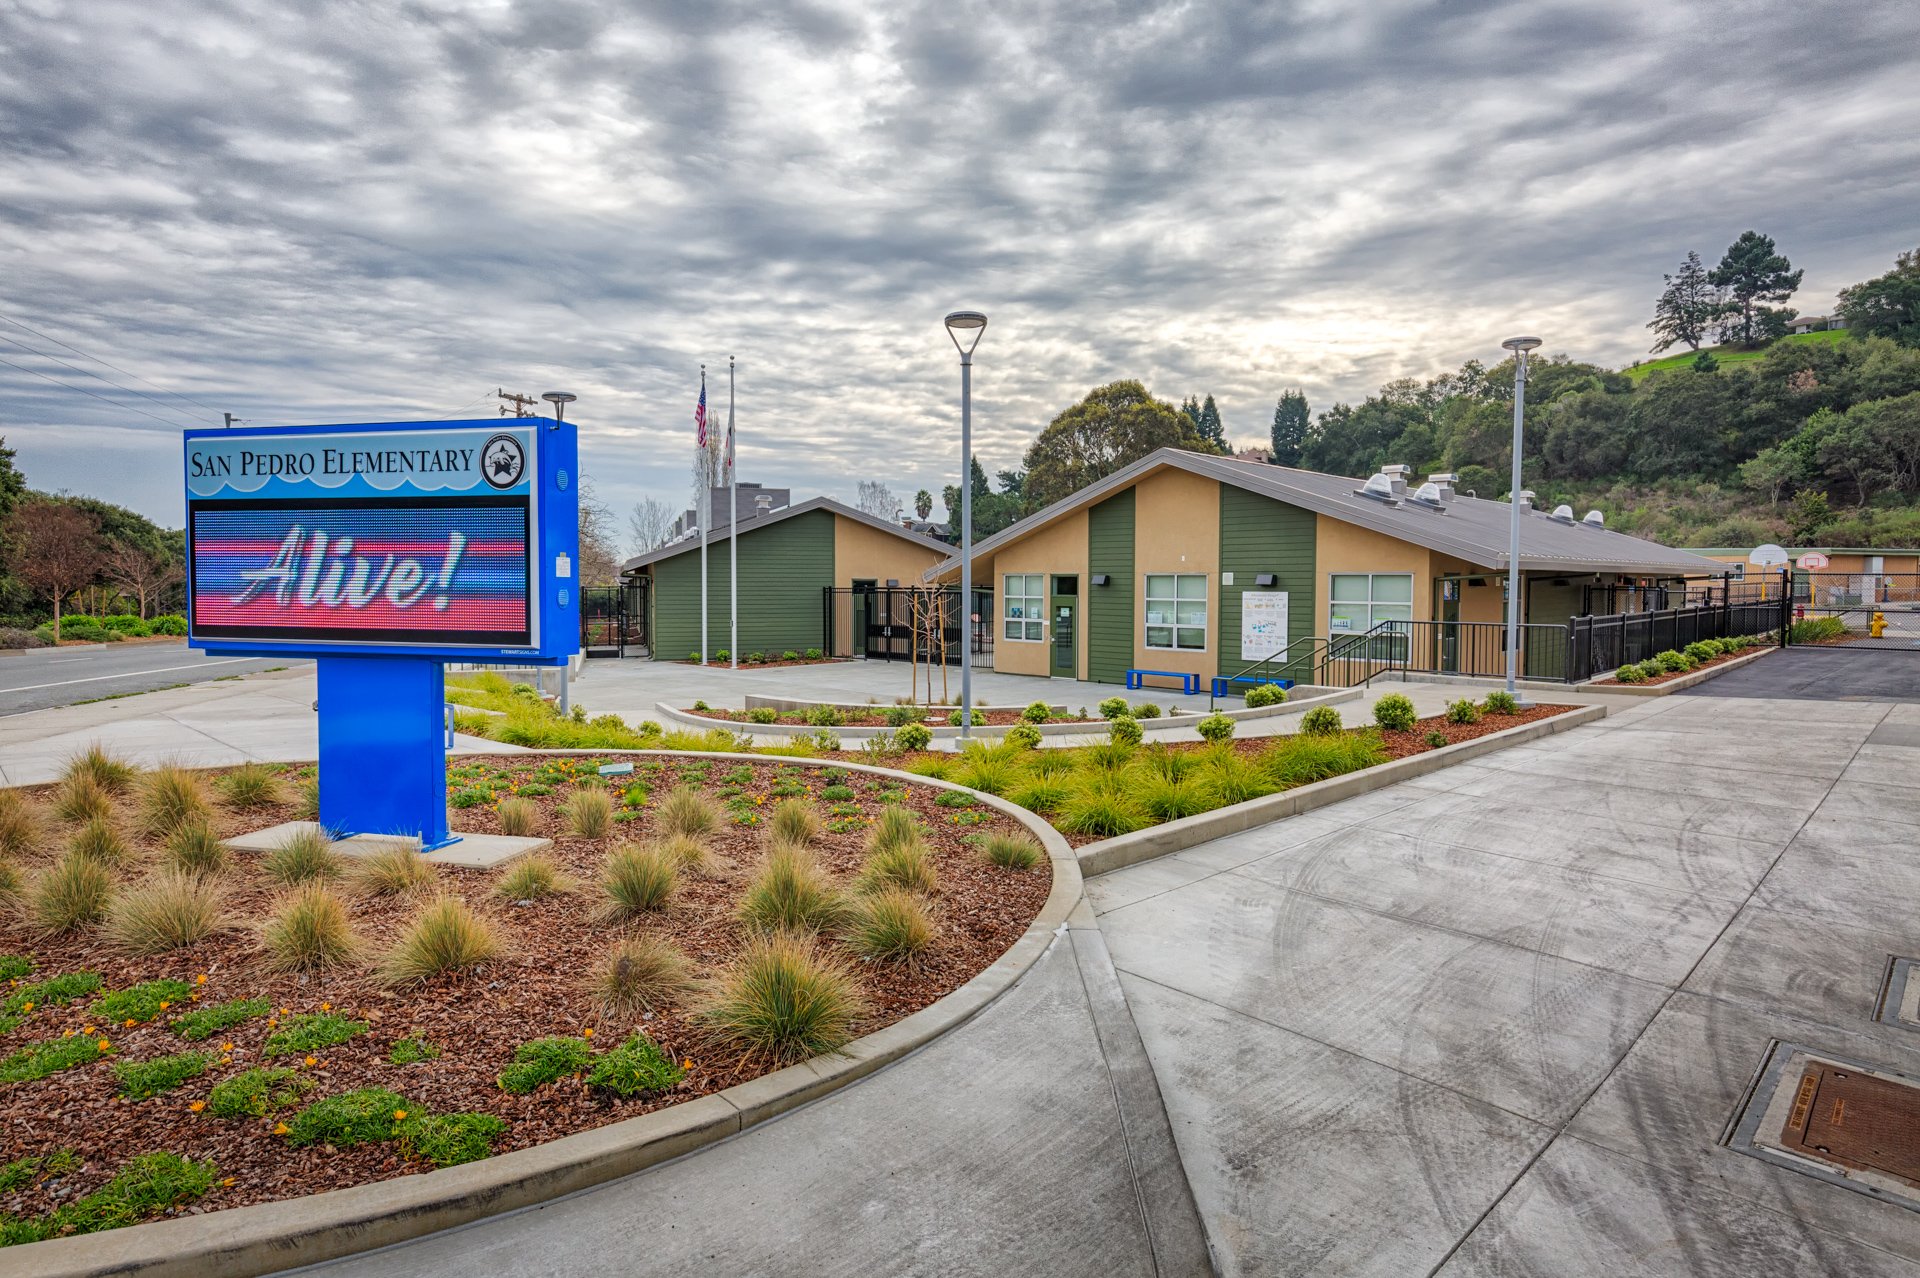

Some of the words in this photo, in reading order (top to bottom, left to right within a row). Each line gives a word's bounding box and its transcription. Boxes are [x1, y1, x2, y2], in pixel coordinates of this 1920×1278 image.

[191, 451, 232, 477] SAN
[240, 451, 315, 476] PEDRO
[322, 449, 474, 474] ELEMENTARY
[230, 523, 468, 612] Alive!
